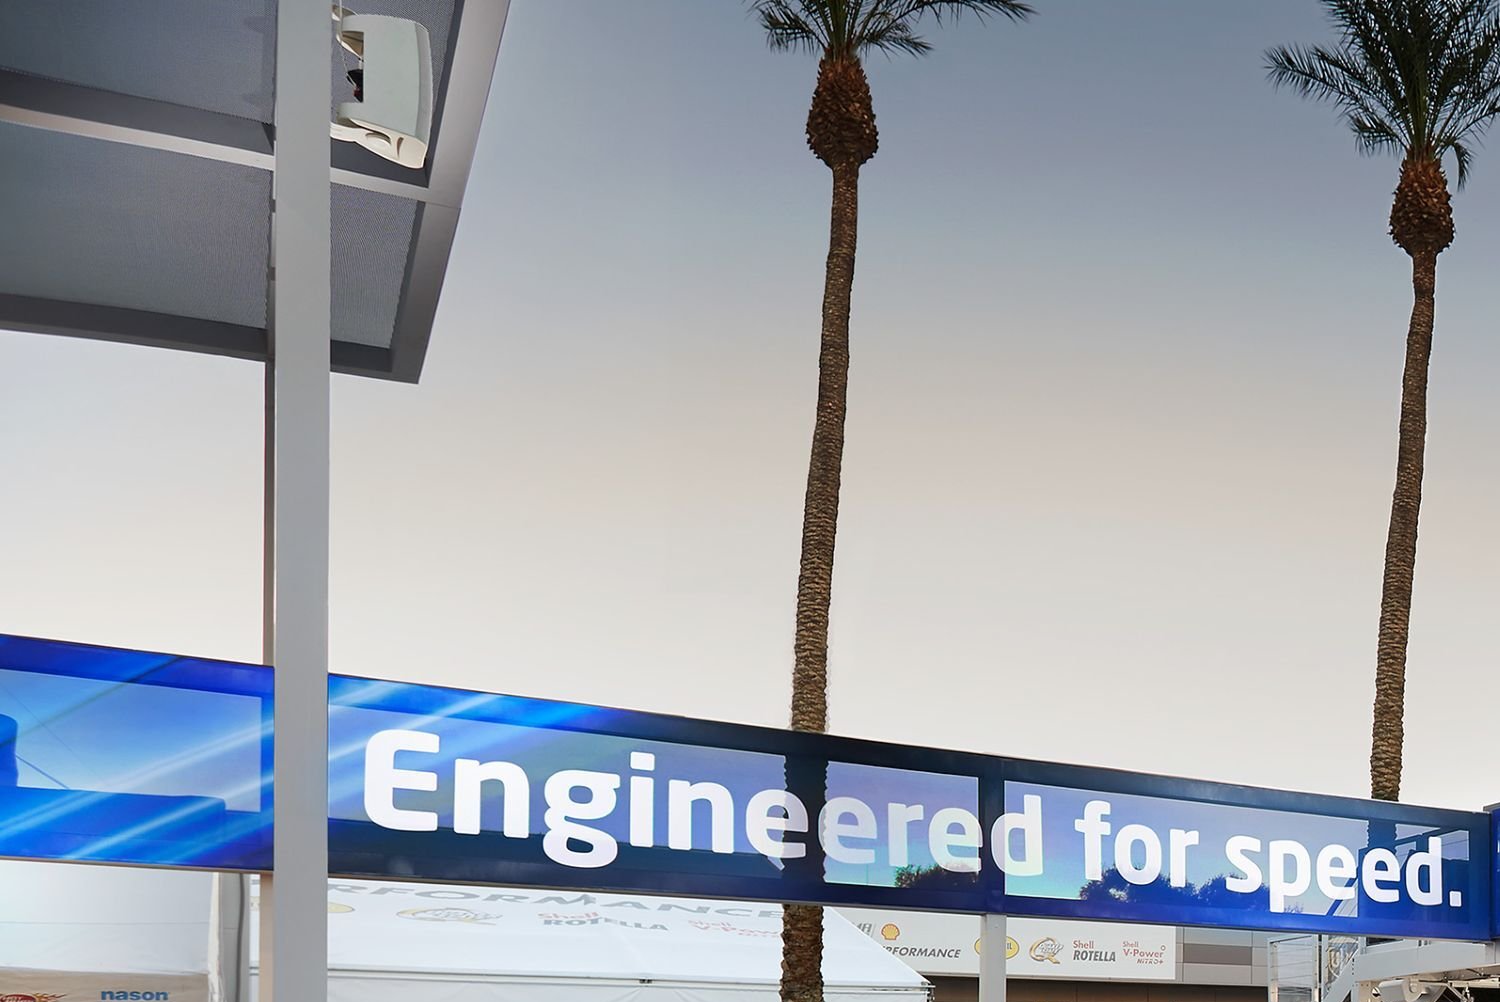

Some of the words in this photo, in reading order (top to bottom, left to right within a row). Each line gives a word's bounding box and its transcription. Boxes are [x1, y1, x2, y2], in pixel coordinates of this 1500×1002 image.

[364, 729, 1043, 877] Engineered
[1074, 800, 1199, 887] for
[1224, 836, 1463, 913] speed.
[1073, 940, 1095, 949] Shell
[882, 946, 961, 959] RFORMANCE
[1073, 950, 1116, 962] ROTELLA
[101, 990, 169, 1001] nason
